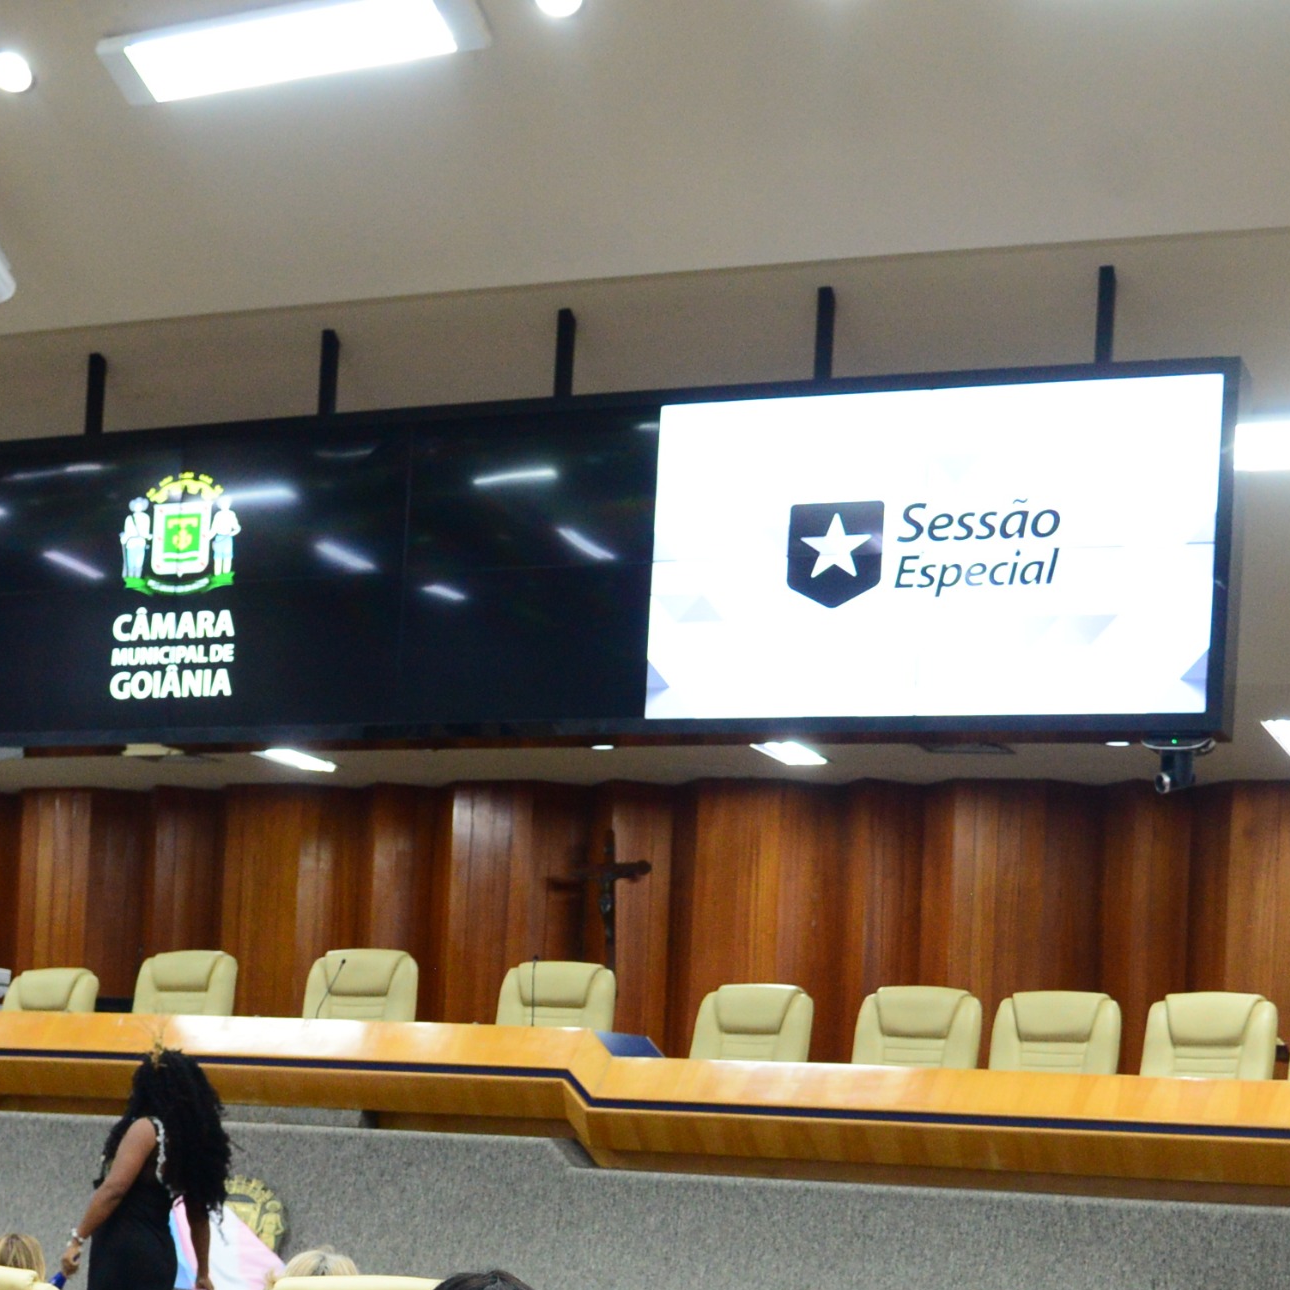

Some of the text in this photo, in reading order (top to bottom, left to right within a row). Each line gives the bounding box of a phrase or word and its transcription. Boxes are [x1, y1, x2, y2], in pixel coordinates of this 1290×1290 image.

[897, 499, 1061, 543] Sessão
[894, 548, 1060, 597] Especial
[112, 606, 235, 642] CÂMARA
[111, 644, 235, 666] MUNICIPAL DE
[109, 665, 232, 700] GOIÂNIA
